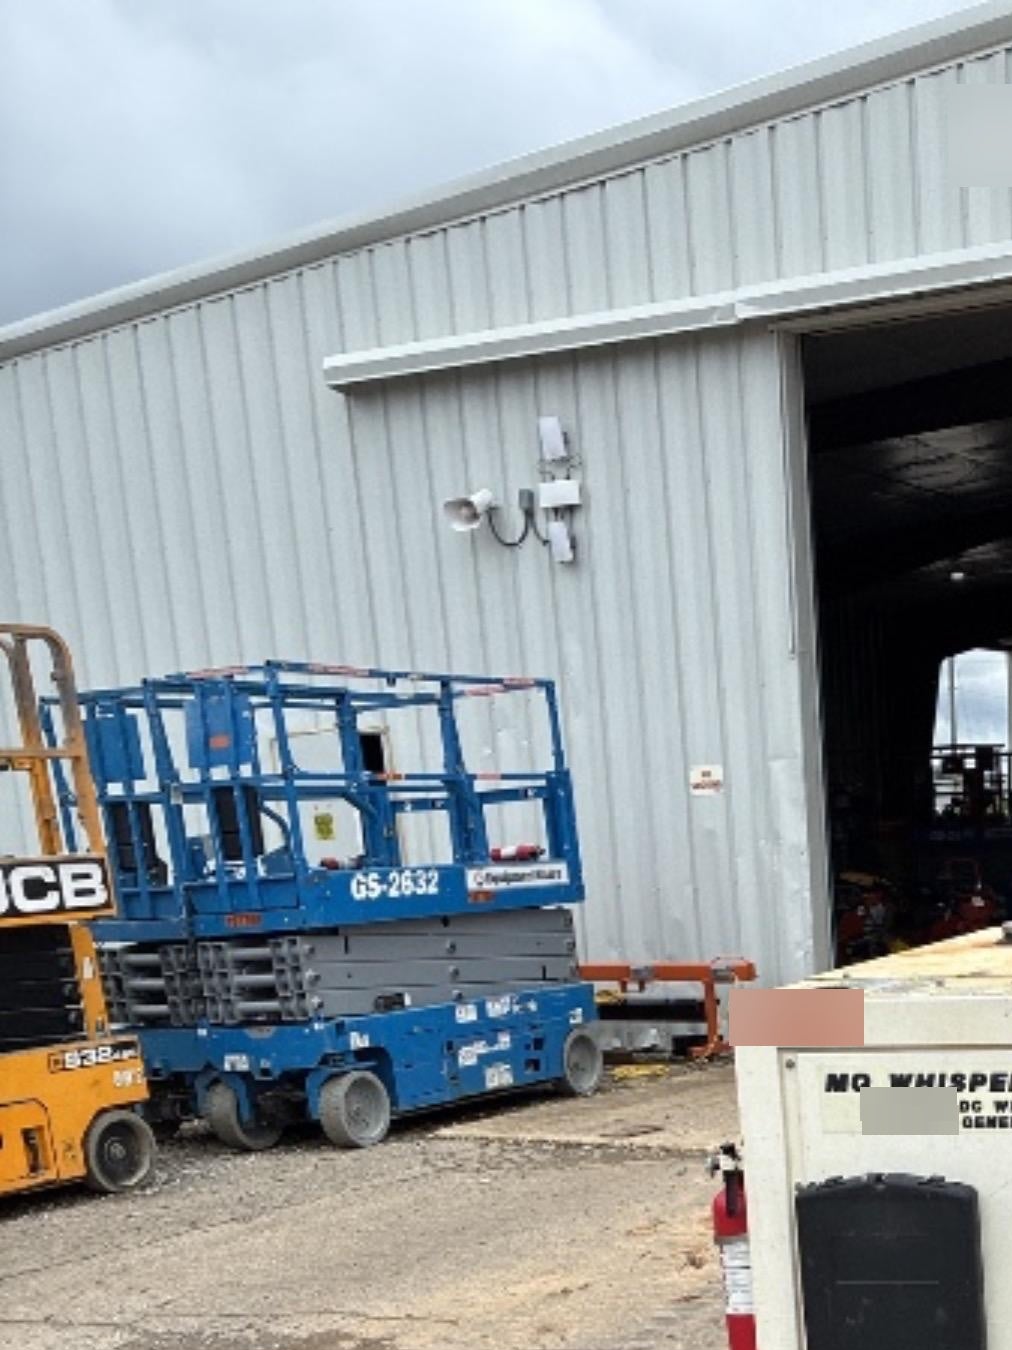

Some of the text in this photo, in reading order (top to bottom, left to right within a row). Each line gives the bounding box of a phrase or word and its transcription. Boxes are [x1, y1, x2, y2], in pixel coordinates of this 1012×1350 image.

[0, 863, 108, 914] CB
[350, 869, 440, 901] GS-2632
[825, 1073, 871, 1093] MQ
